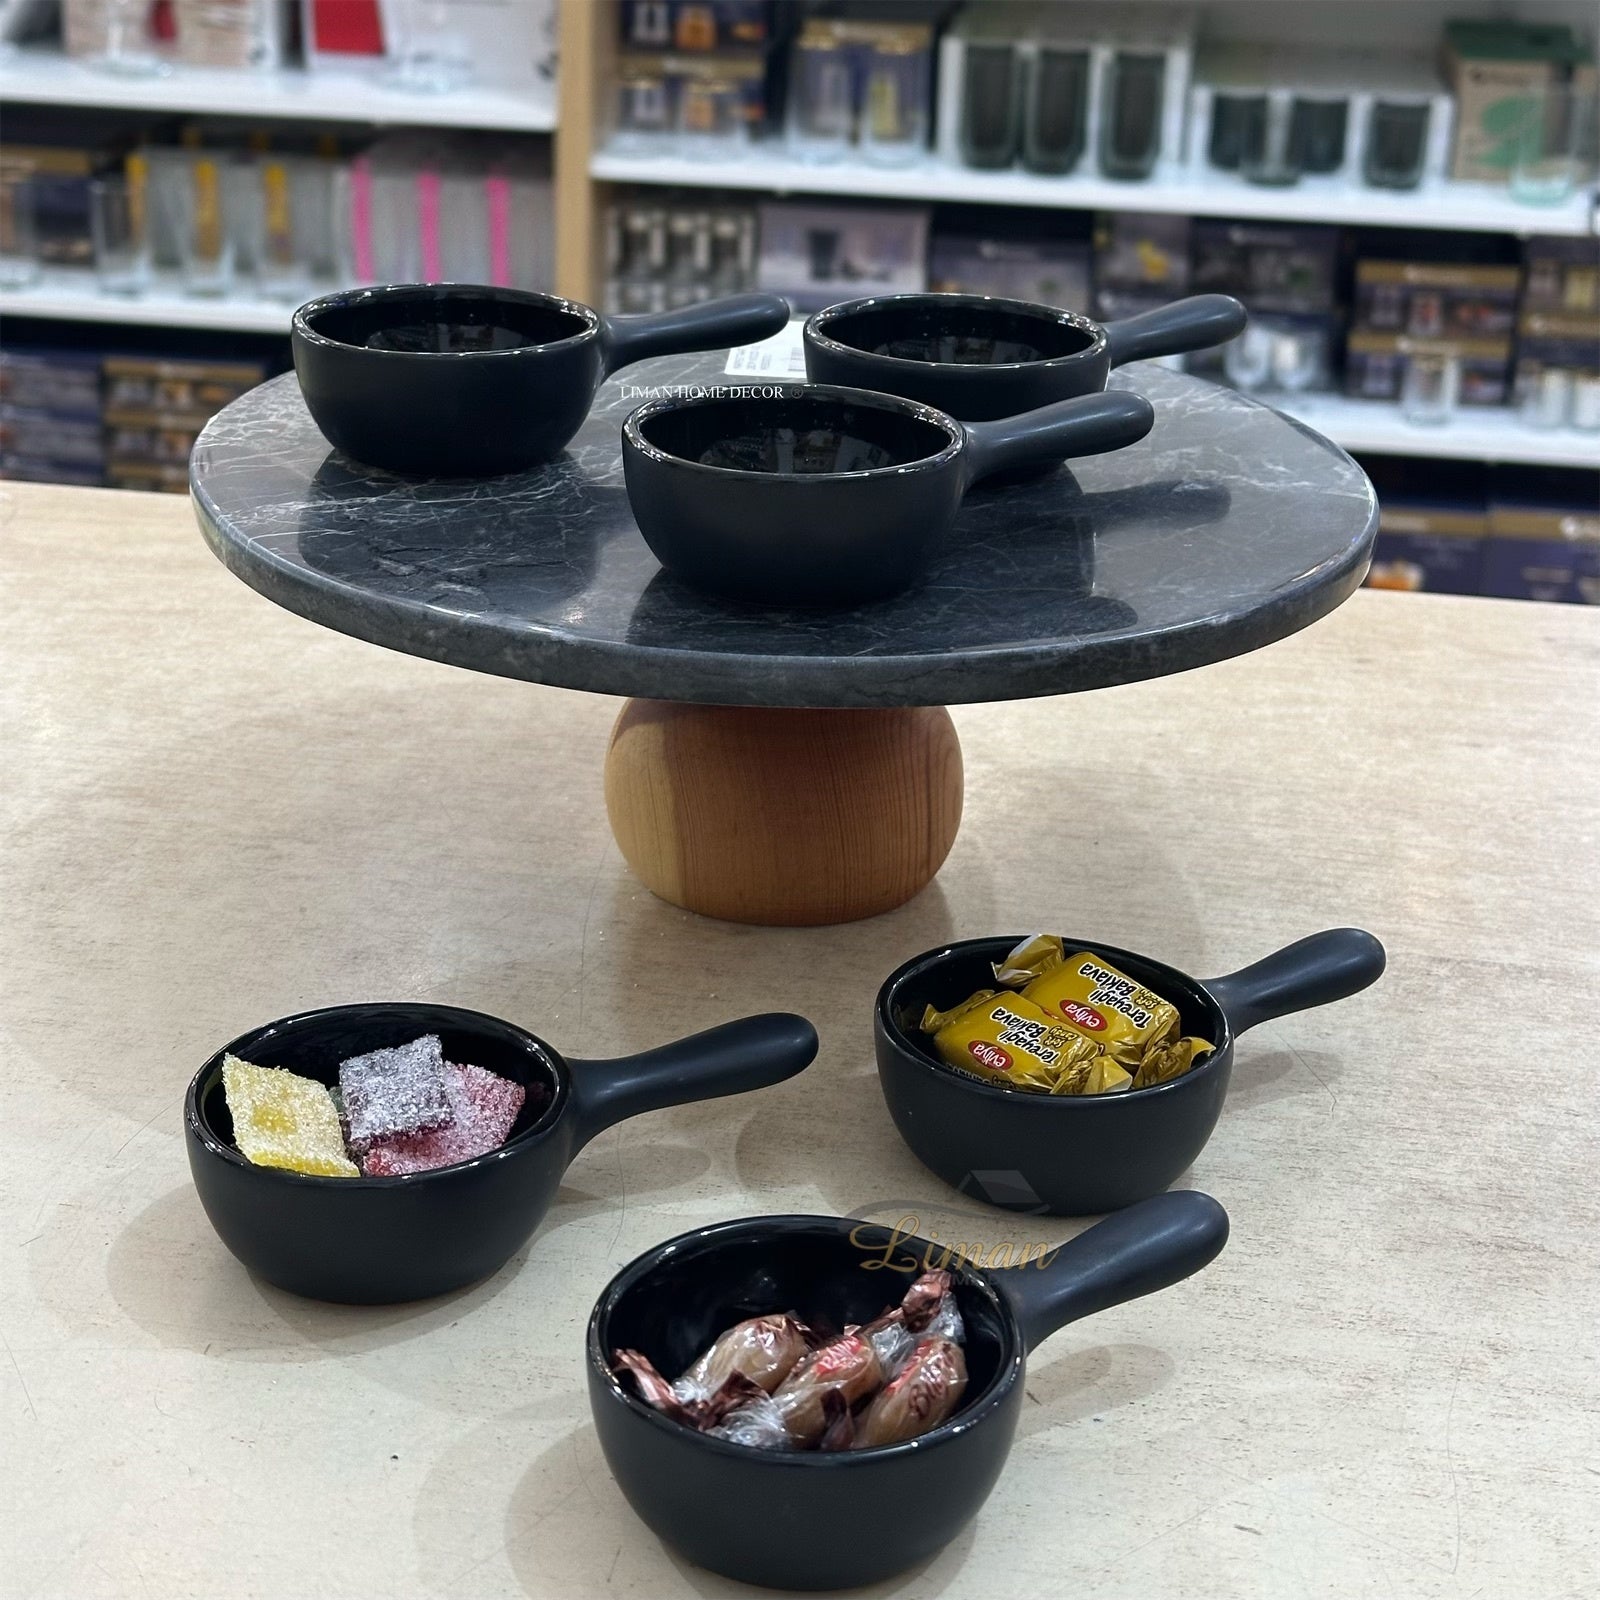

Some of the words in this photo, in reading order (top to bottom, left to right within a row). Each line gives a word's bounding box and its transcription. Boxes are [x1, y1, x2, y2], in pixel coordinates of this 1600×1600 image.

[1078, 962, 1139, 997] Baklava
[990, 1006, 1049, 1039] Baklava
[1065, 1002, 1101, 1028] evliya
[973, 1042, 1006, 1068] evliya
